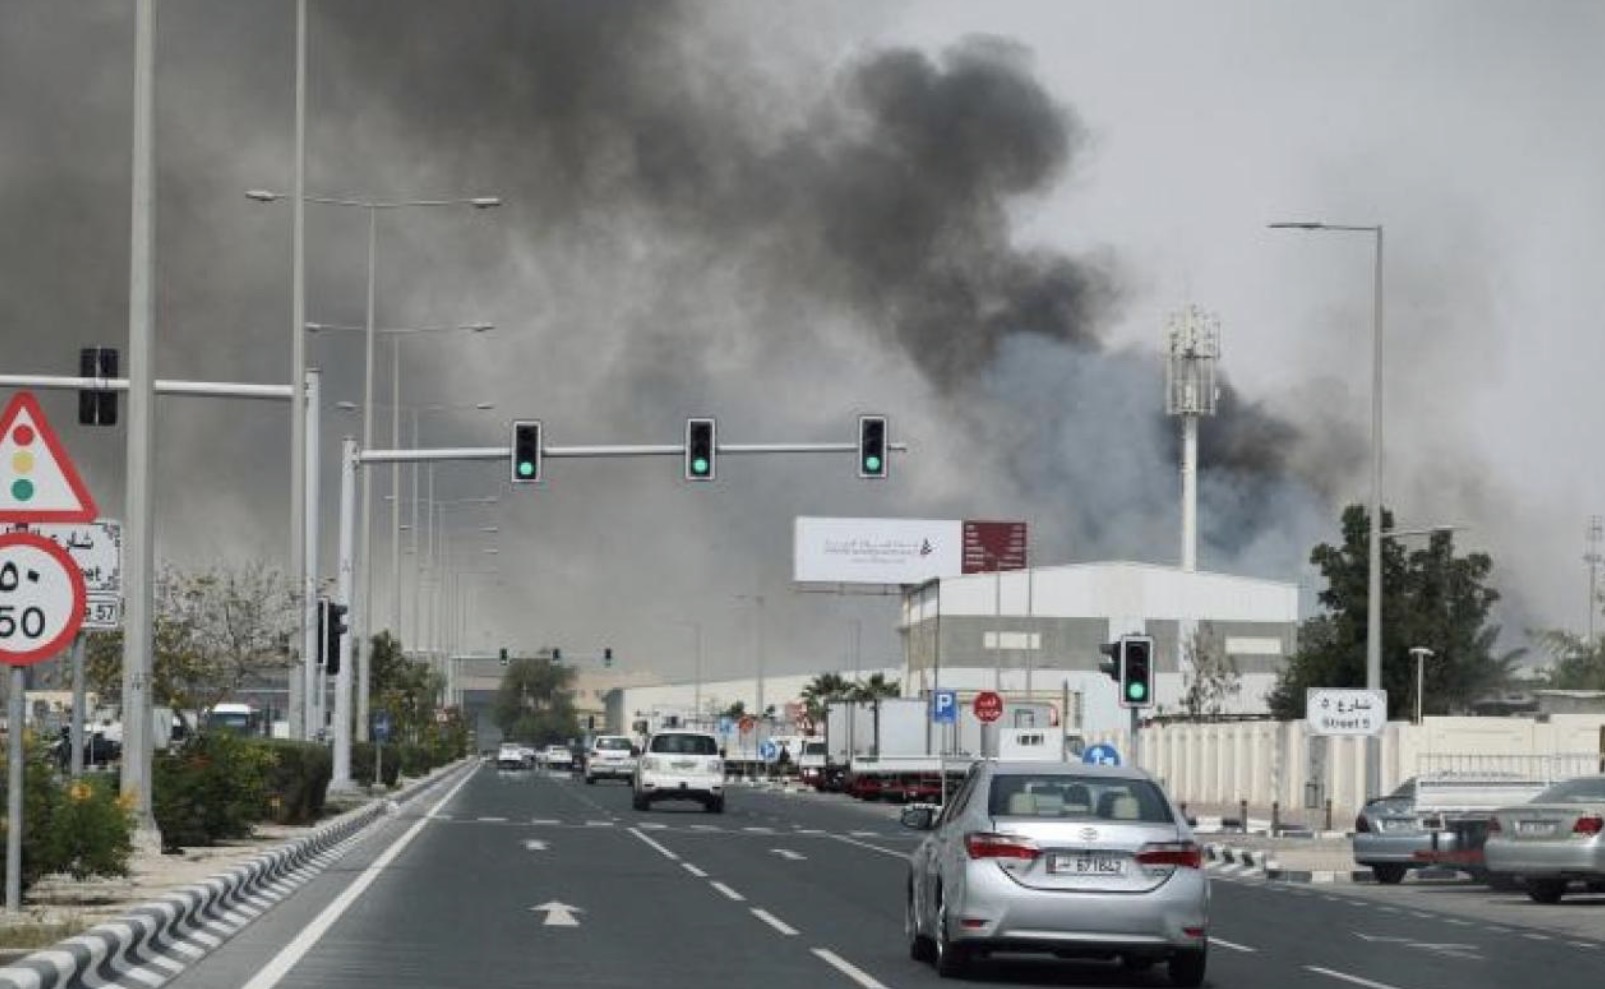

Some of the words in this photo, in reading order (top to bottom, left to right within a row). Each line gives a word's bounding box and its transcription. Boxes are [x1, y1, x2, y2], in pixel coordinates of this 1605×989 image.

[97, 604, 115, 620] 57
[0, 605, 45, 638] 50
[937, 694, 952, 712] P
[1337, 698, 1371, 713] شارع
[1321, 717, 1359, 729] Street
